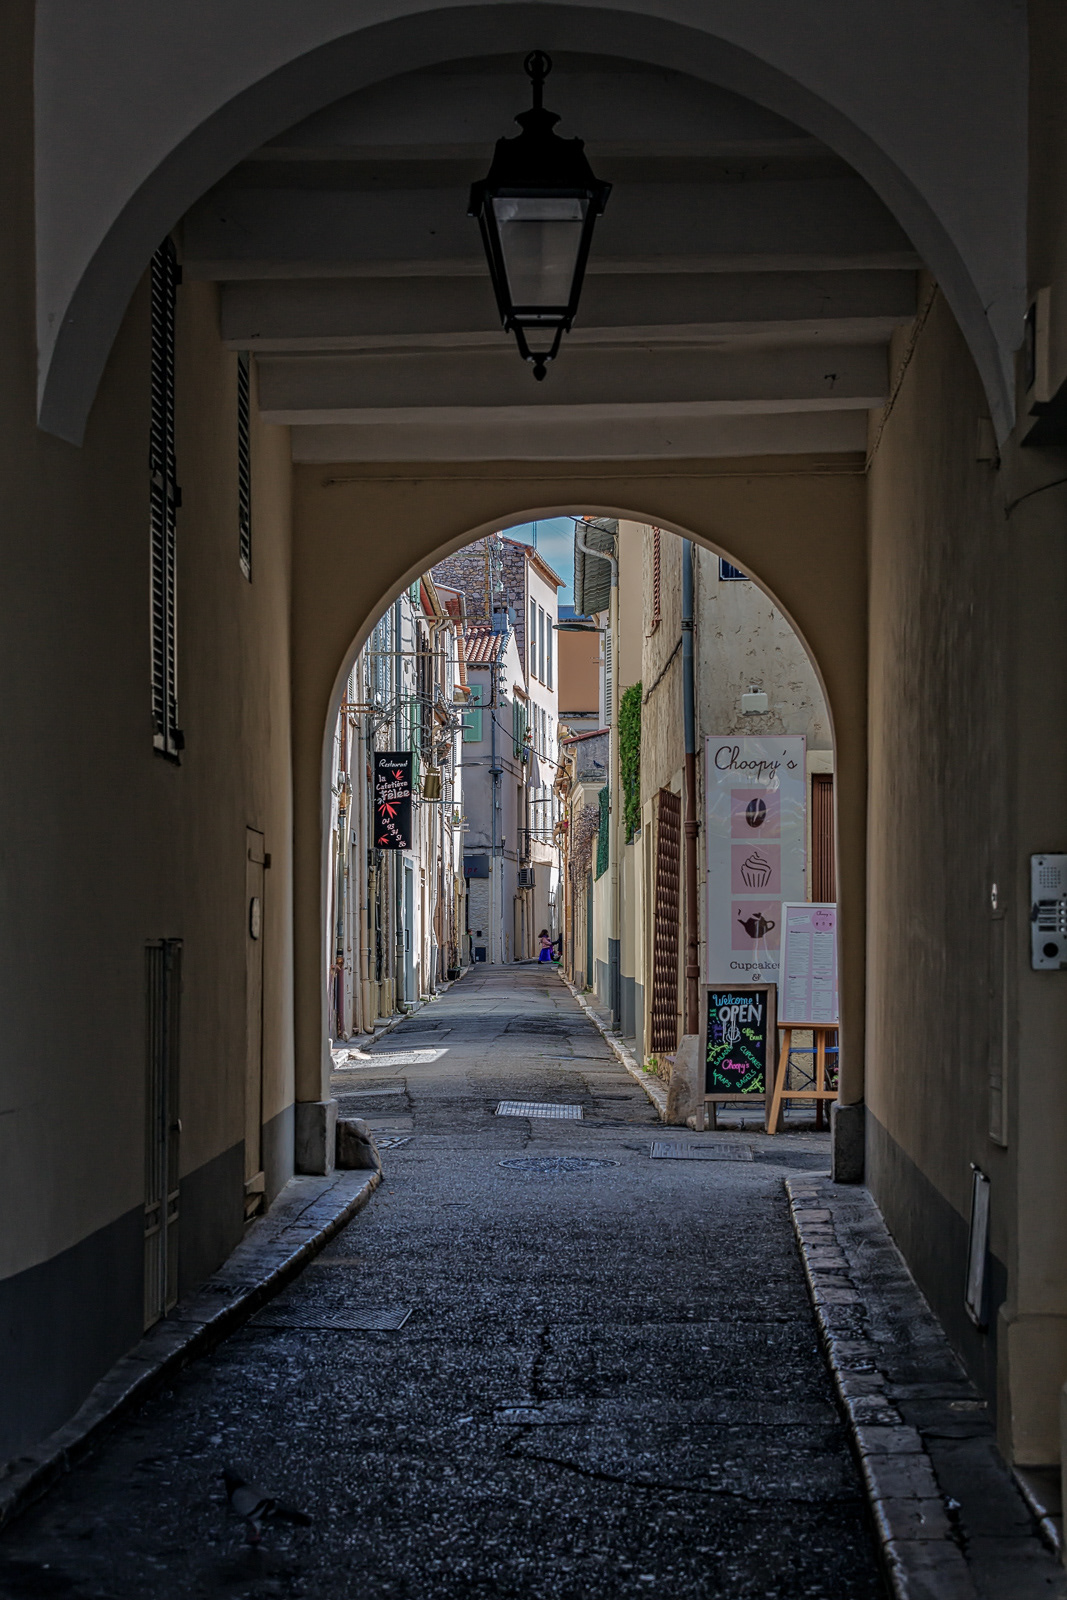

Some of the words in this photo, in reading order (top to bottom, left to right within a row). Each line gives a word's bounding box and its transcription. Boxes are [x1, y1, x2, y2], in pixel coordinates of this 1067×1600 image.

[379, 759, 408, 767] Restaurant
[714, 745, 798, 780] Choopy's
[752, 973, 761, 982] &
[718, 1004, 763, 1024] OPEN
[721, 1059, 750, 1074] Choopy's
[735, 1069, 757, 1088] BAGELS
